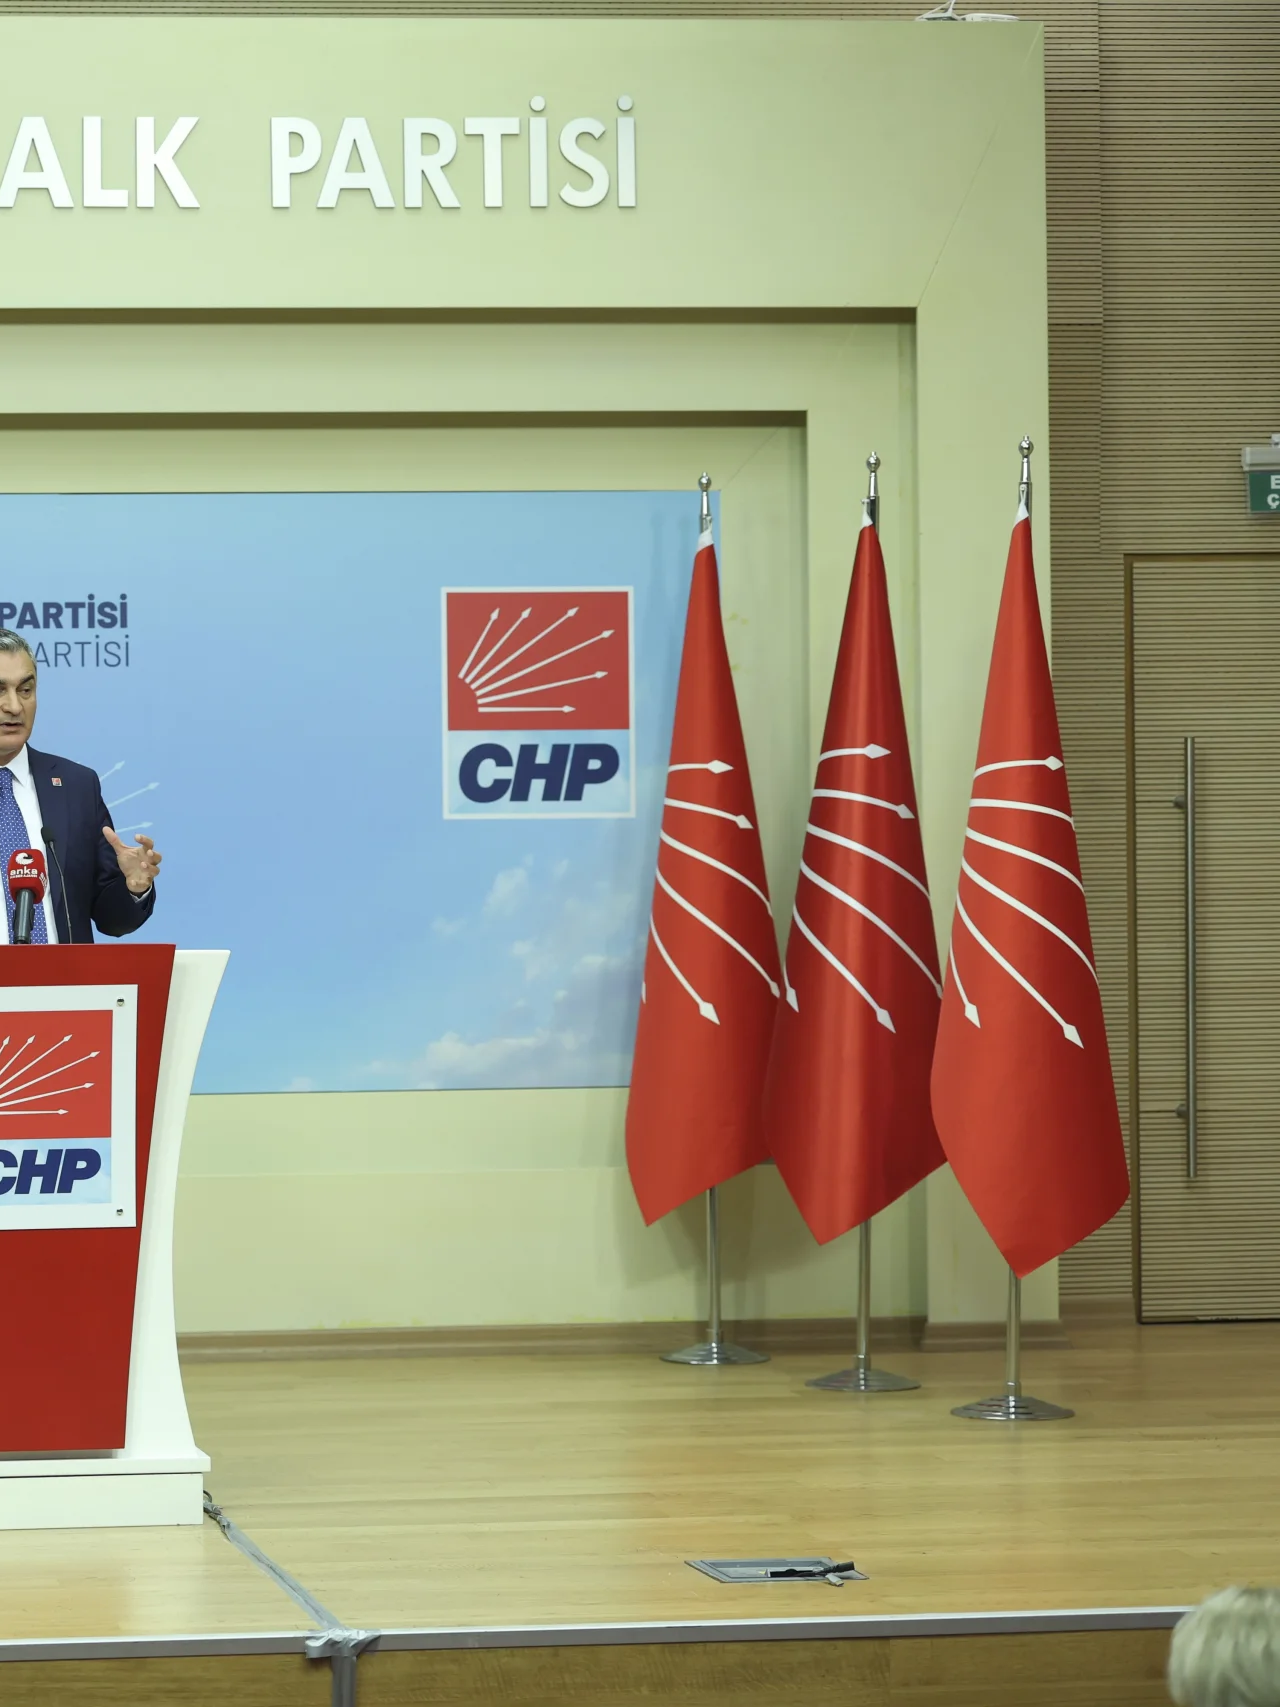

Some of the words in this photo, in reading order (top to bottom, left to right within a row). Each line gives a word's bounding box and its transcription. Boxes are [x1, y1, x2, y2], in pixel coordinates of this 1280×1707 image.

[271, 96, 636, 208] PARTİSİ
[34, 634, 130, 668] ARTİSİ
[458, 742, 621, 804] CHP
[9, 866, 38, 876] anka
